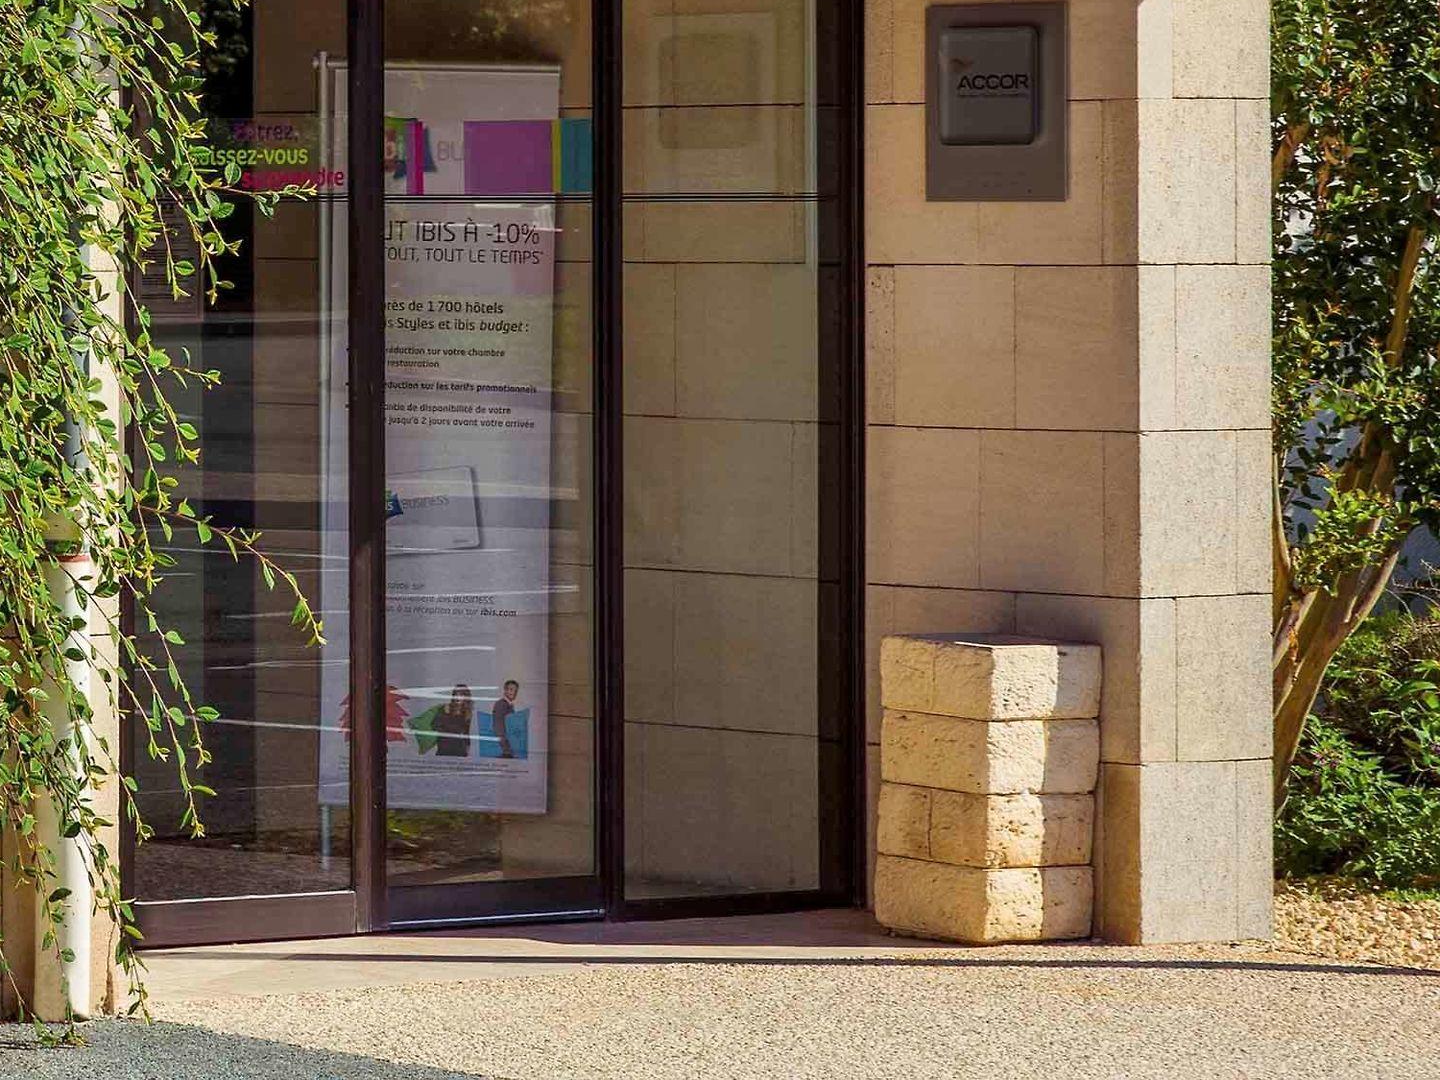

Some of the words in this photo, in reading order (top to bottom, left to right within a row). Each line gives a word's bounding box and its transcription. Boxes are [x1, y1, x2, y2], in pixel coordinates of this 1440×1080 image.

[956, 73, 1029, 90] ACCOR
[191, 145, 308, 166] aissez-vous
[416, 221, 456, 242] IBIS
[464, 218, 478, 242] À
[487, 223, 540, 245] -10%
[385, 247, 419, 263] OUT,
[425, 248, 464, 262] TOUT
[469, 248, 485, 263] LE
[385, 300, 405, 311] rès
[408, 301, 423, 311] de
[465, 301, 504, 314] hôtels
[397, 317, 435, 331] Styles
[438, 320, 451, 330] et
[455, 318, 475, 331] ibis
[443, 348, 465, 356] votre
[467, 348, 505, 357] chambre
[387, 359, 440, 368] restauration
[385, 382, 419, 390] duction
[436, 382, 448, 391] les
[450, 383, 474, 392] tarifs
[476, 384, 537, 394] promotionnels
[408, 402, 418, 411] de
[475, 404, 486, 414] de
[489, 406, 511, 415] votre
[429, 416, 451, 427] jours
[453, 418, 478, 426] avant
[480, 419, 503, 427] votre
[505, 419, 535, 429] arrivée
